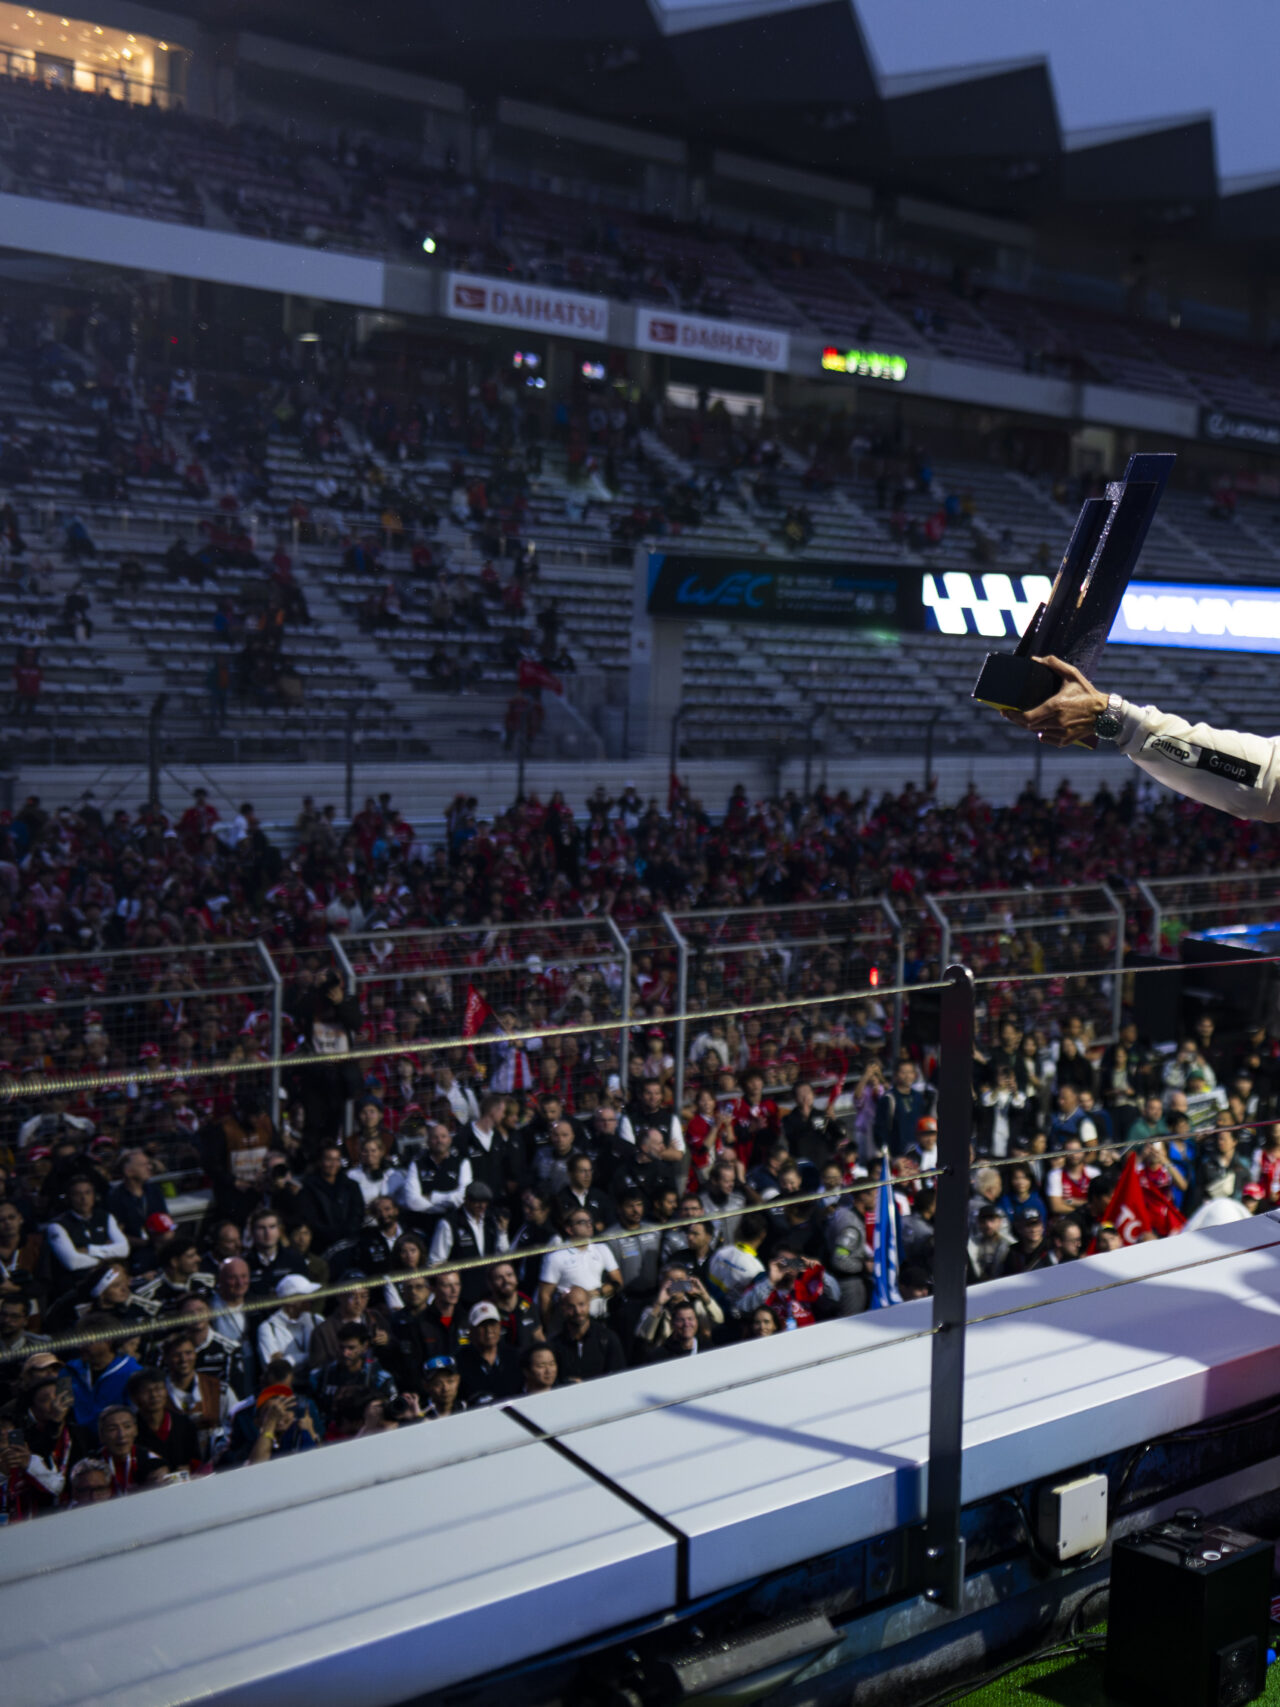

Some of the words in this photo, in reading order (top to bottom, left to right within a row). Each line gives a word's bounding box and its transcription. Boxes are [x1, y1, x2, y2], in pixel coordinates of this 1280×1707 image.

[491, 290, 605, 333] DAIHATSU
[681, 323, 780, 363] DAIHATSU
[675, 569, 774, 608] WEC
[1209, 755, 1247, 778] Group
